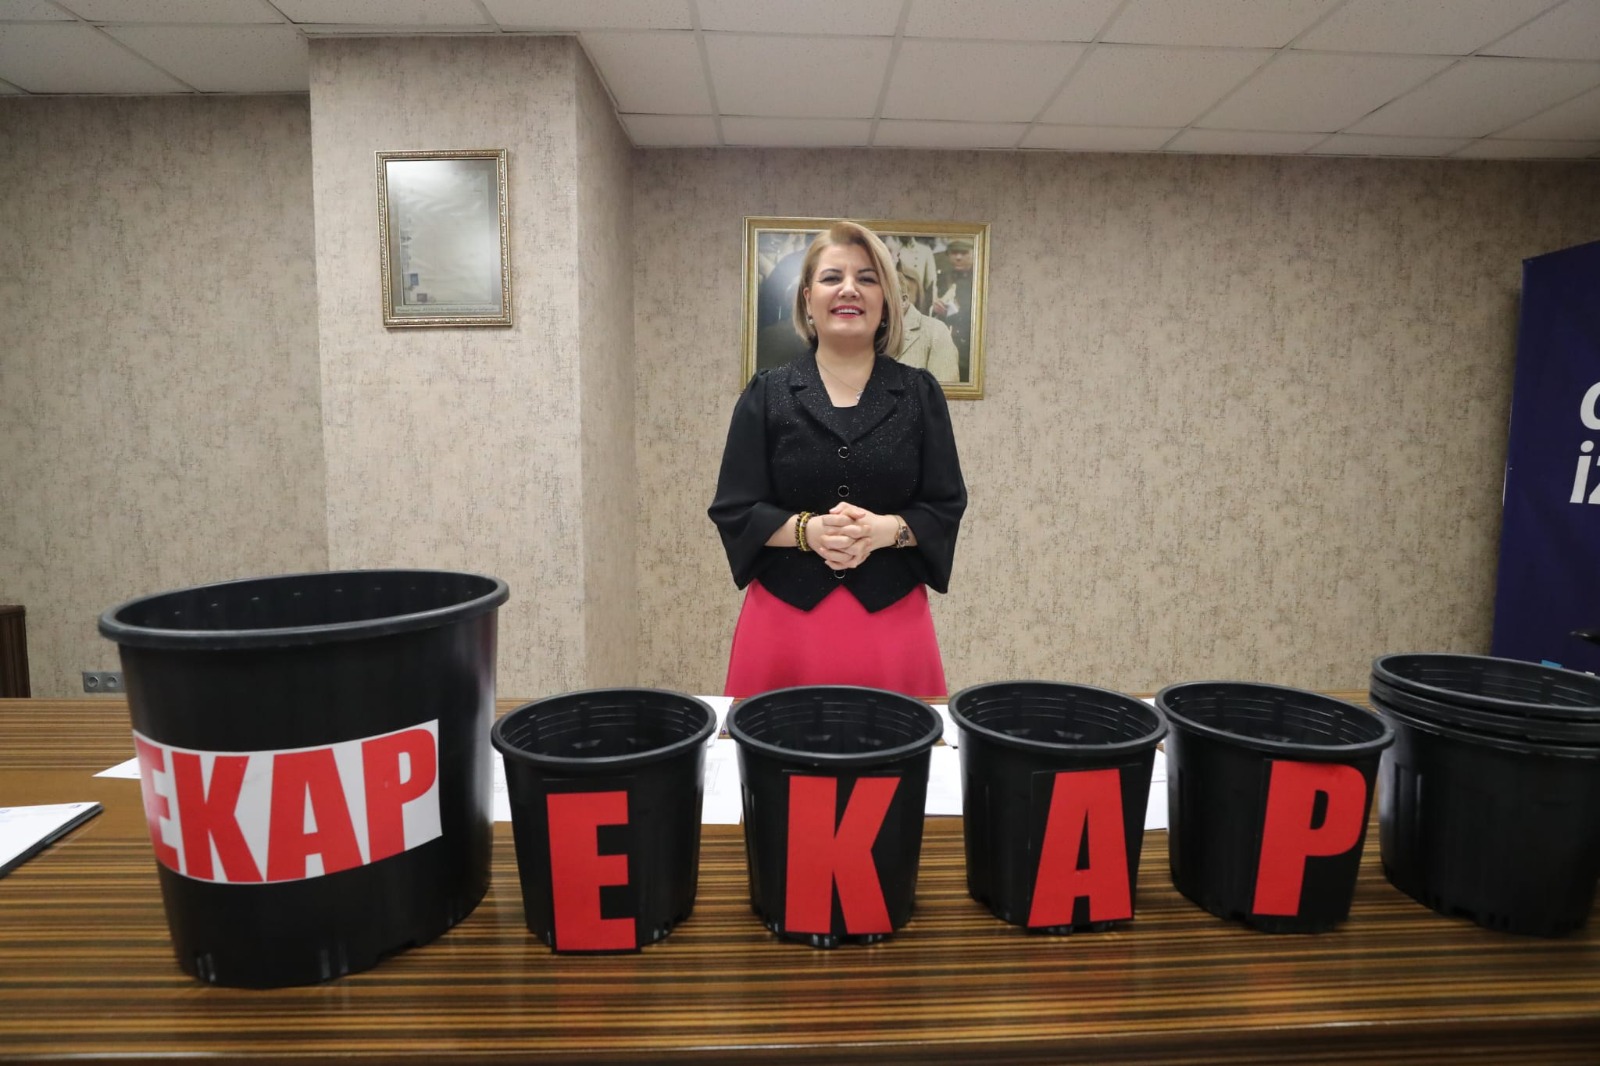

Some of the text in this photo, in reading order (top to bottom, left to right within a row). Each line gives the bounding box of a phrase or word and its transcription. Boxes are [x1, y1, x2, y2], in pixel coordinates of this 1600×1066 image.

[134, 728, 437, 882] EKAP
[546, 790, 636, 951] E
[785, 775, 901, 934] K
[1027, 768, 1132, 928] A
[1252, 760, 1367, 917] P
